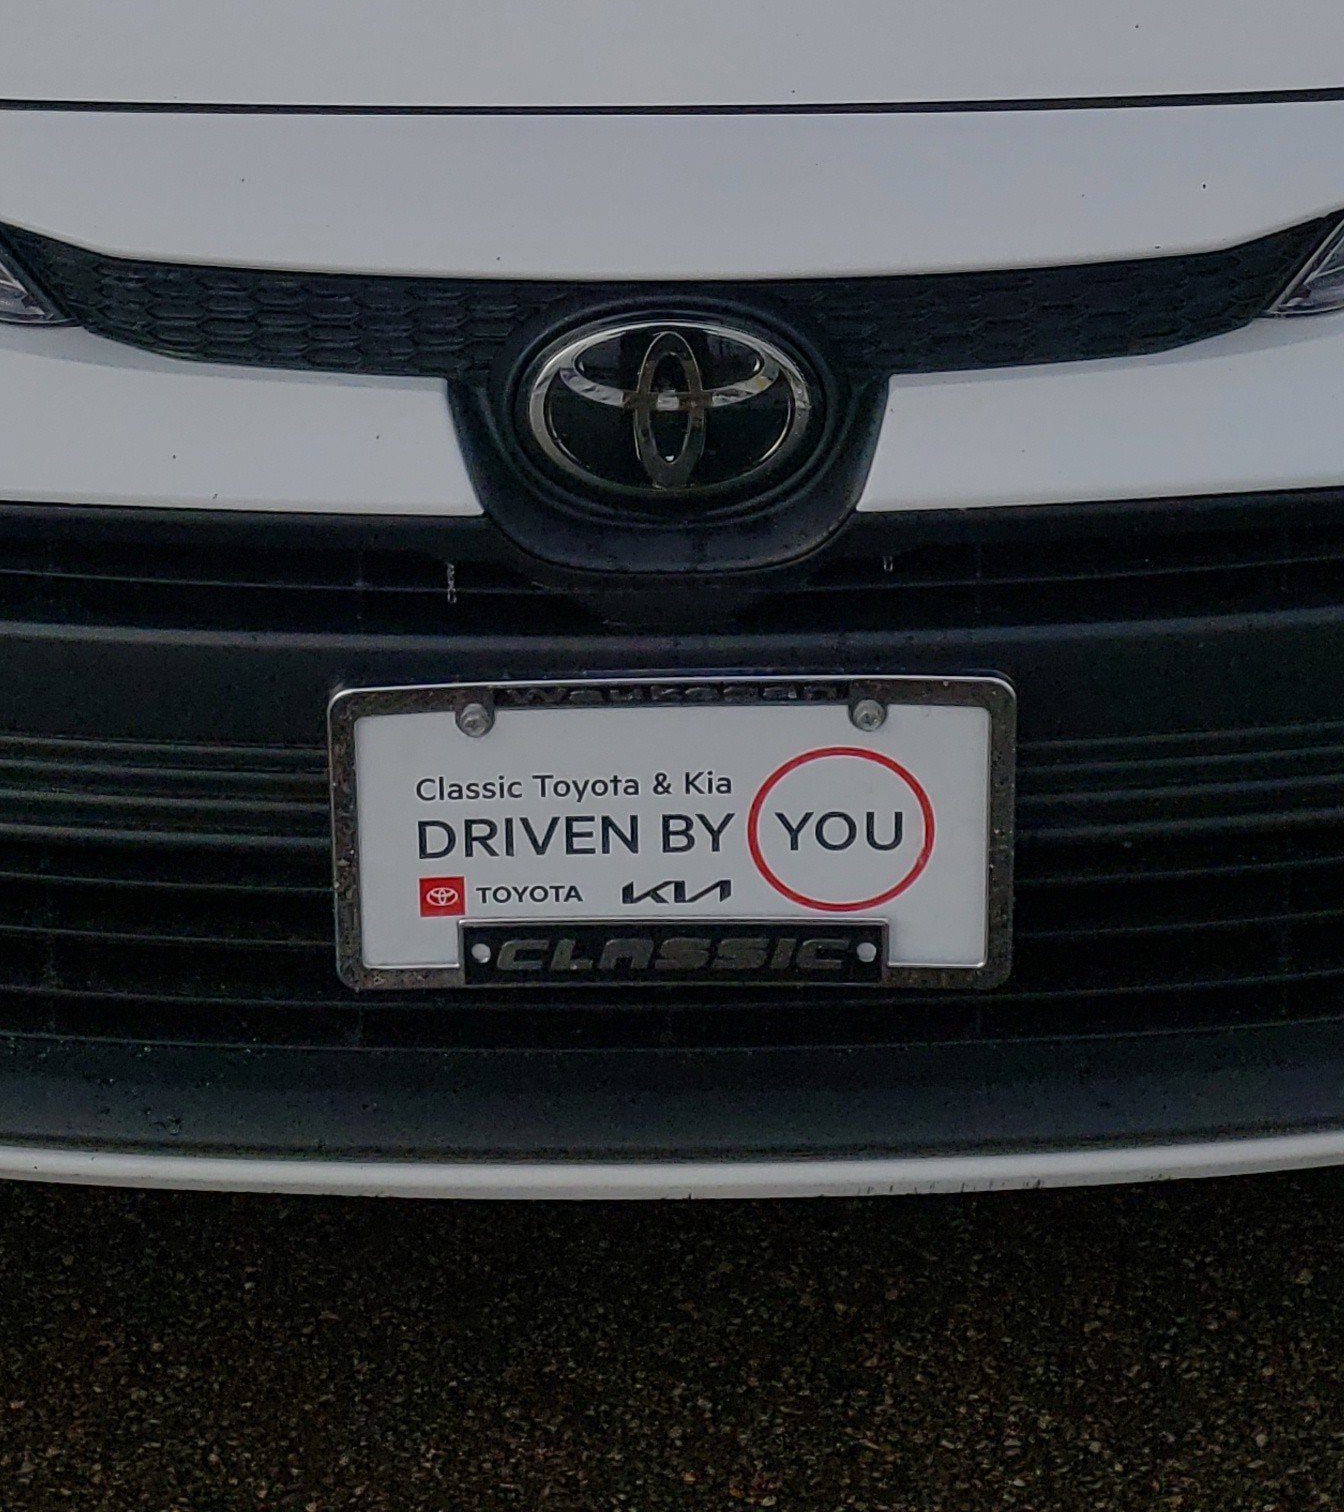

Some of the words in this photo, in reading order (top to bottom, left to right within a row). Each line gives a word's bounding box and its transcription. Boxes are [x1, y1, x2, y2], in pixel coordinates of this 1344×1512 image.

[416, 775, 523, 801] Classic
[532, 774, 640, 802] Toyota
[652, 771, 672, 795] &
[685, 770, 733, 795] Kia
[417, 814, 639, 859] DRIVEN
[661, 813, 735, 853] BY
[774, 811, 903, 851] YOU
[476, 885, 583, 904] TOYOTA
[622, 879, 732, 904] KIA
[496, 937, 852, 971] CLASSIC
